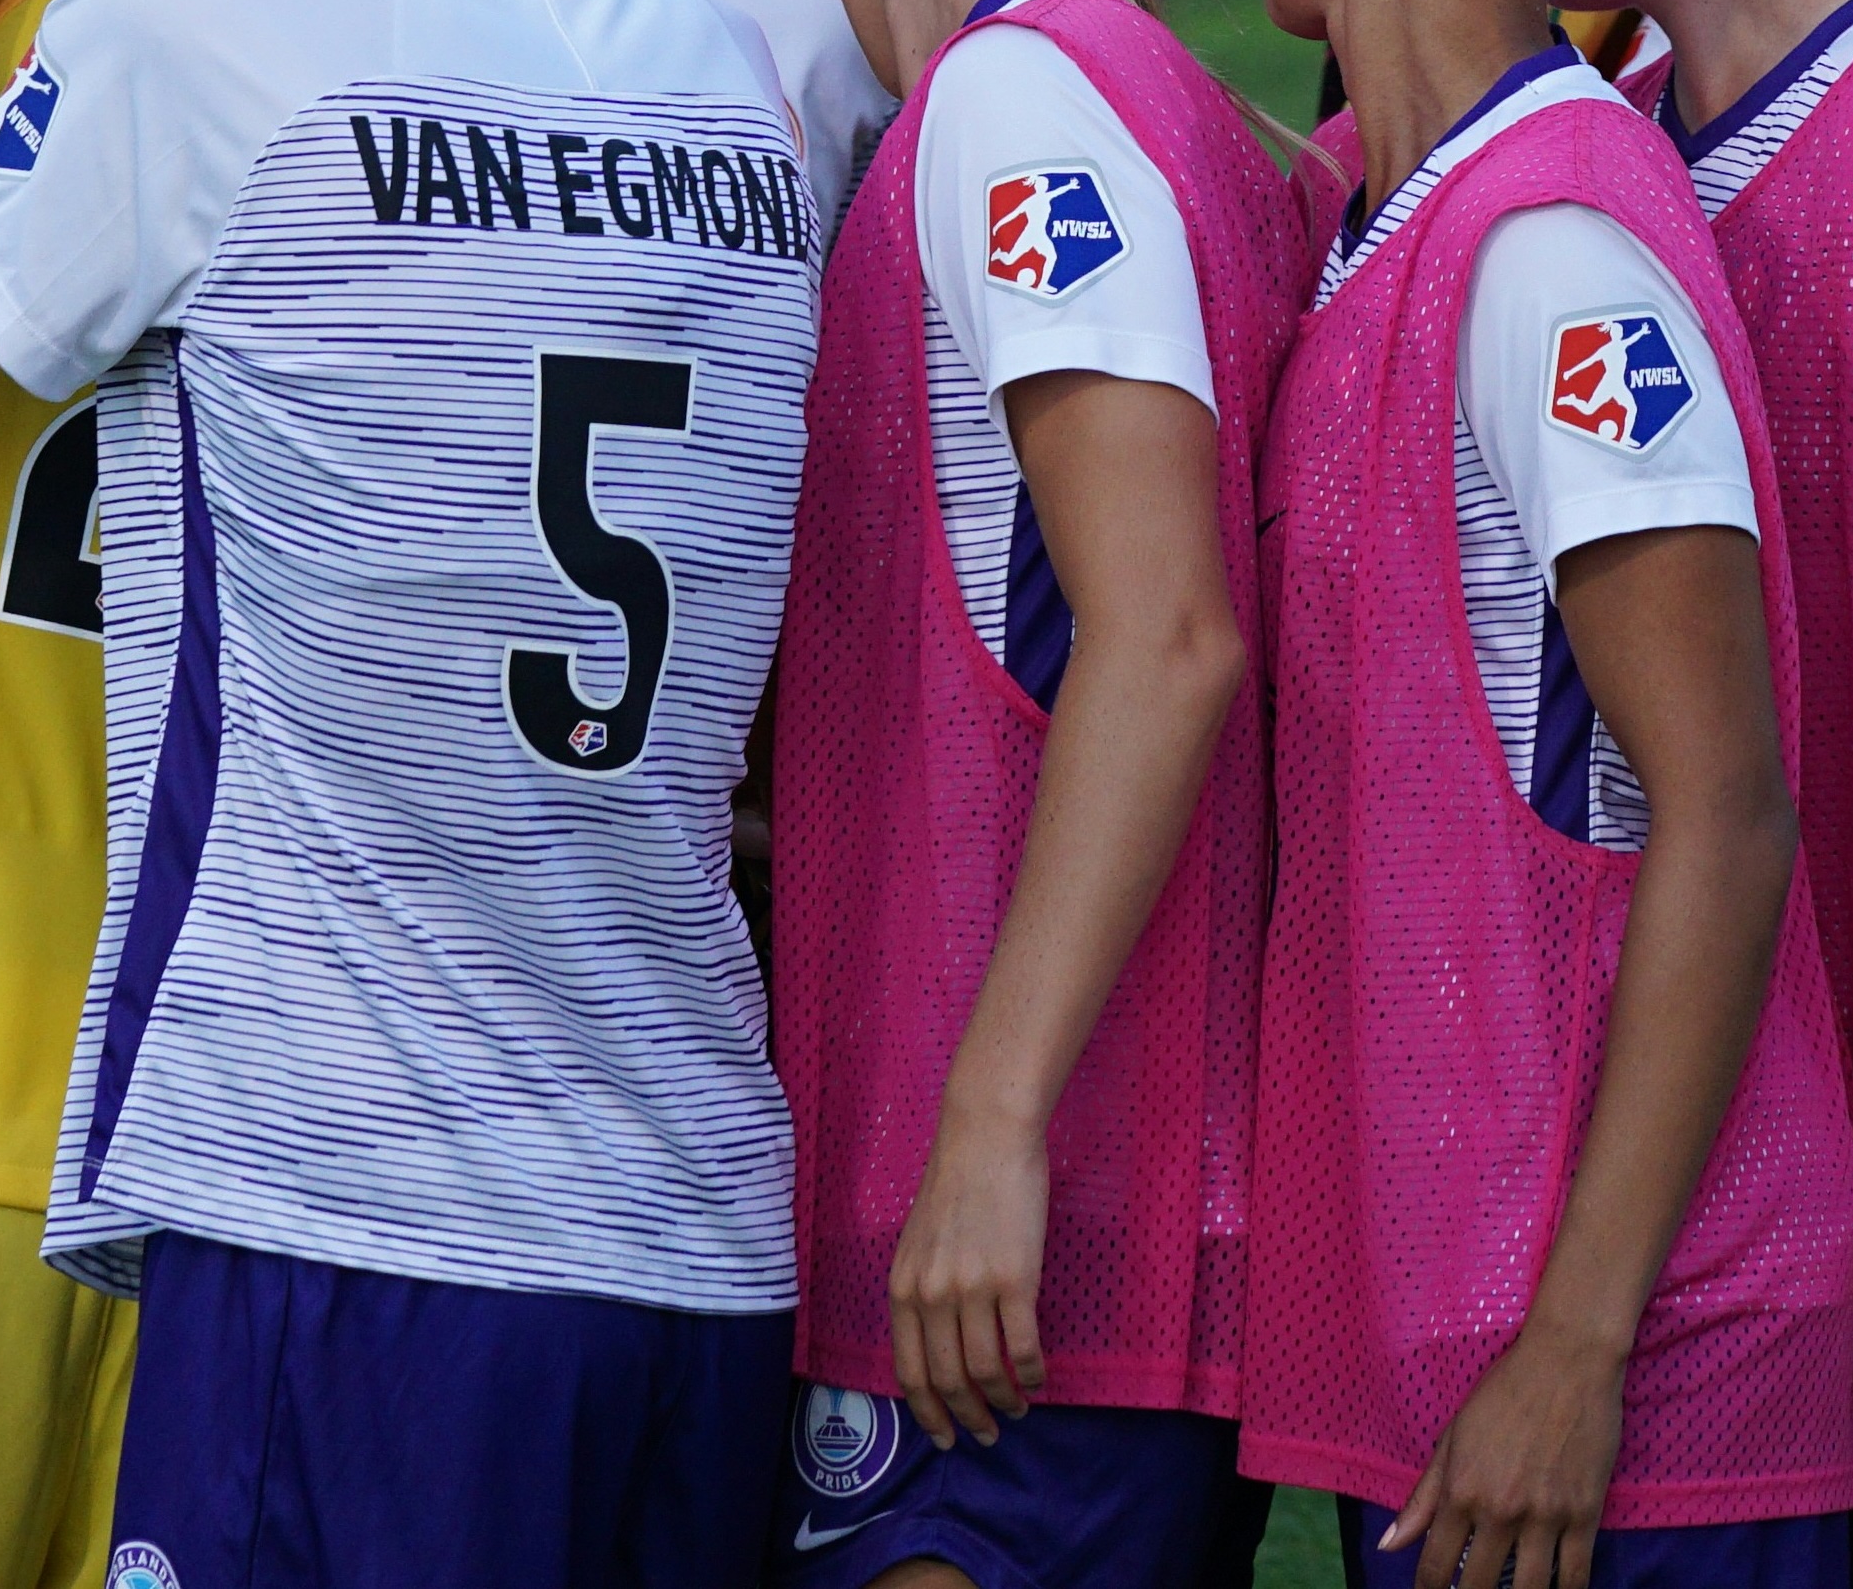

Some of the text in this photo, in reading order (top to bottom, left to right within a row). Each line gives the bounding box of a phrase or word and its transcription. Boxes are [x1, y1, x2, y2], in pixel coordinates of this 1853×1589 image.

[6, 104, 43, 154] NWSL
[349, 115, 531, 231] VAN
[1051, 219, 1112, 240] NWSL
[1630, 366, 1682, 389] NWSL
[500, 344, 700, 780] 5
[814, 1468, 862, 1490] PRIDE
